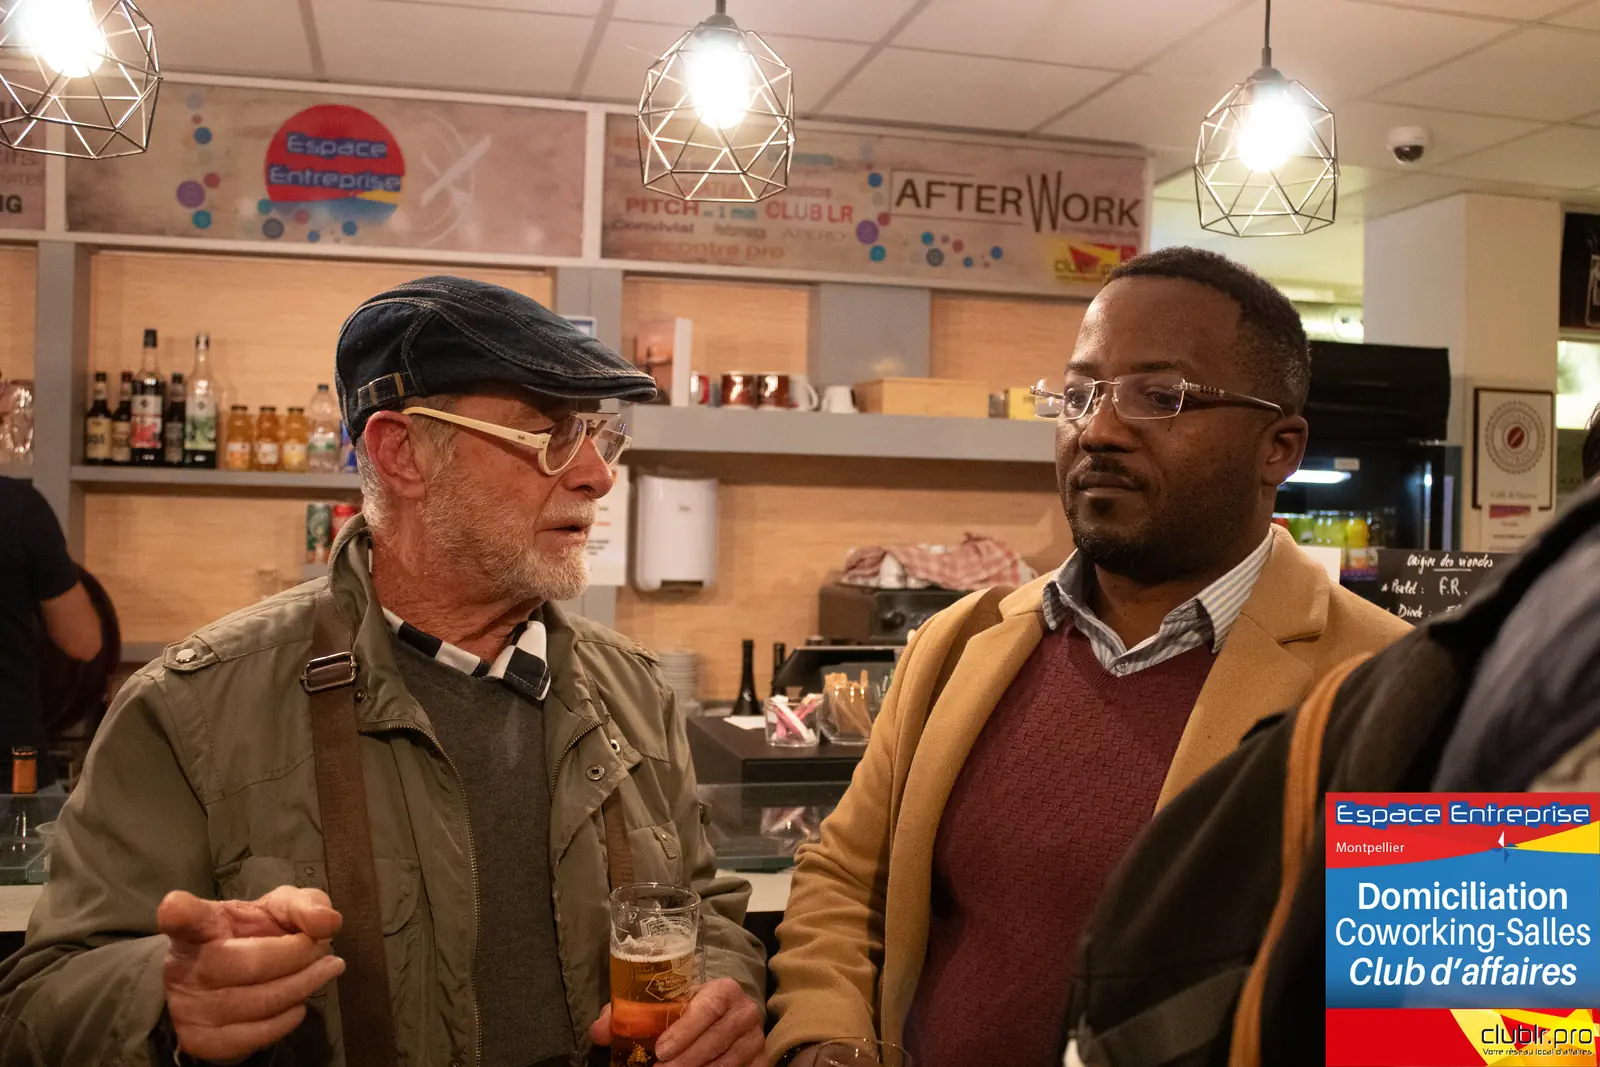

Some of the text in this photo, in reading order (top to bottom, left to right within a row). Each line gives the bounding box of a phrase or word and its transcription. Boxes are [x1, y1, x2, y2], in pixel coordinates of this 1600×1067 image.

[287, 132, 387, 158] Espace
[269, 164, 401, 192] Entreprise
[626, 197, 699, 217] PITCH
[765, 200, 853, 224] CLUB LR
